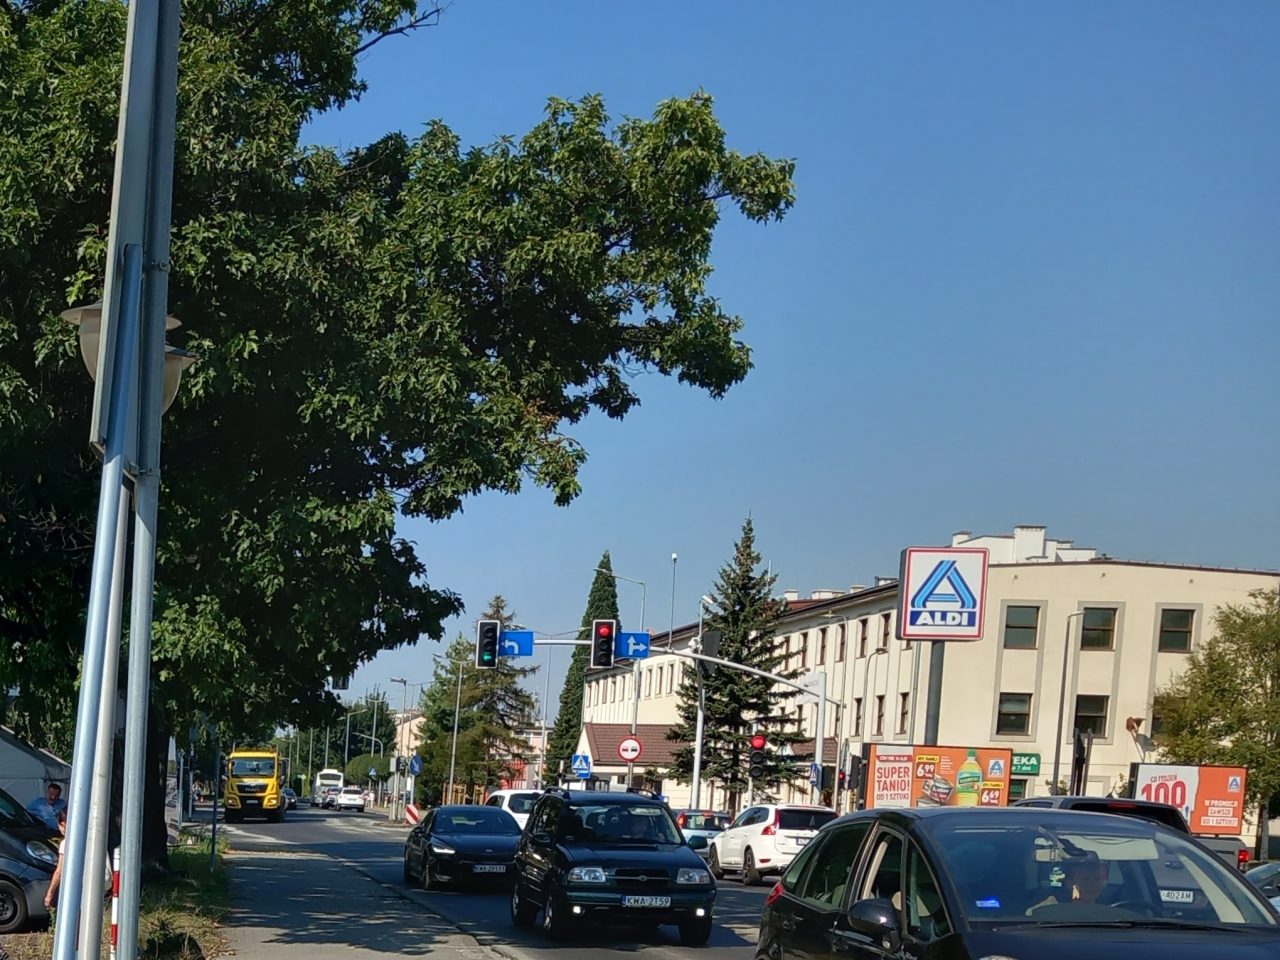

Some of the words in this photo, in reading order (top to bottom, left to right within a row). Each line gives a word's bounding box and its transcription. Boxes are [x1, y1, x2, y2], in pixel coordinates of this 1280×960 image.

[915, 611, 969, 626] ALDI
[1012, 756, 1037, 765] EKA
[877, 766, 910, 779] SUPER
[876, 780, 910, 792] TANIO!
[1141, 780, 1186, 808] 100
